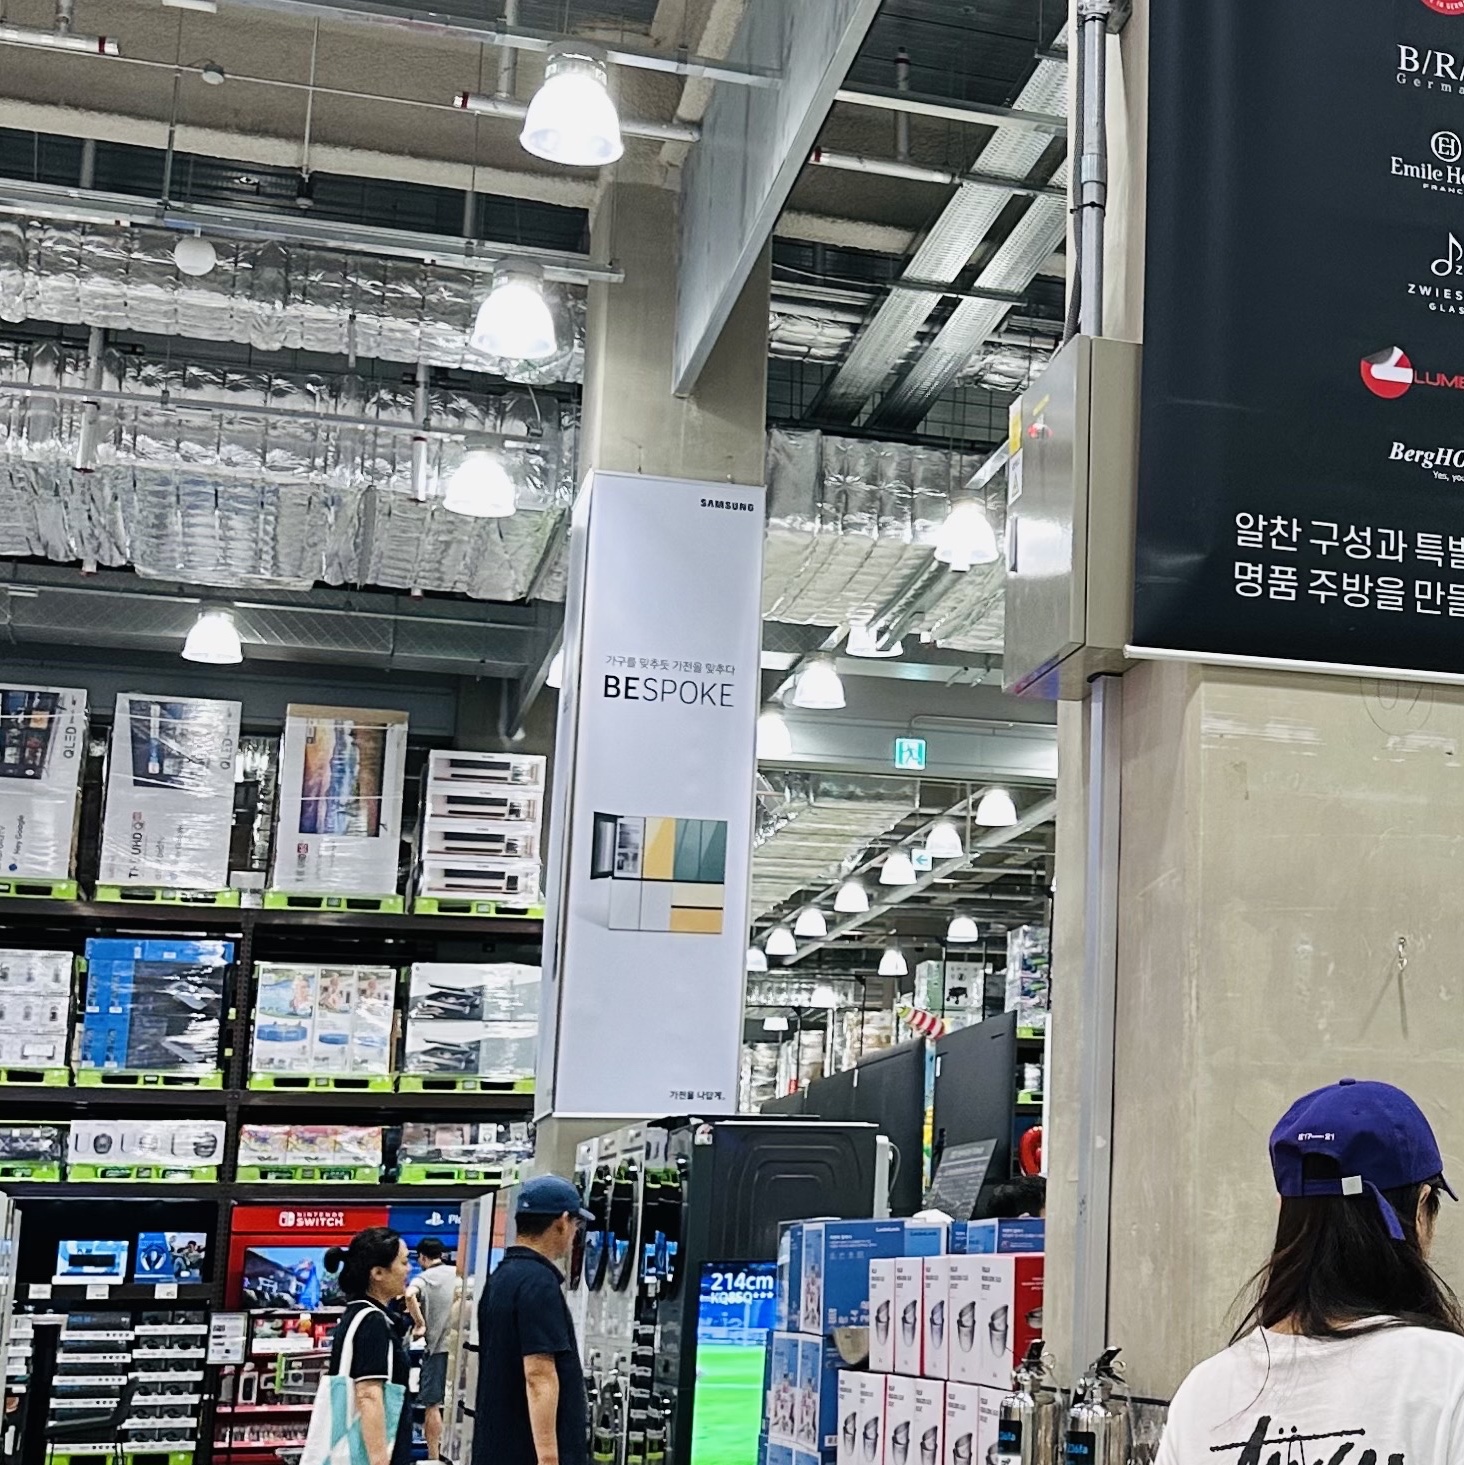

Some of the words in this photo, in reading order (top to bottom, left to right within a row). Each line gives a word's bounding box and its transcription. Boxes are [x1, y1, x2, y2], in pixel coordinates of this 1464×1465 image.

[1390, 156, 1444, 182] Emile
[1432, 470, 1450, 482] Yes,
[700, 498, 754, 512] SAMSUNG
[1234, 512, 1301, 551] 알찬
[1309, 520, 1408, 563] 구성과
[1233, 563, 1299, 602] 명품
[1308, 572, 1405, 613] 주방을
[605, 655, 637, 667] 가구를
[672, 661, 702, 673] 가전을
[604, 675, 735, 708] BESPOKE
[63, 726, 77, 759] QLED
[296, 1217, 344, 1227] SWITCH
[711, 1272, 774, 1290] 214cm
